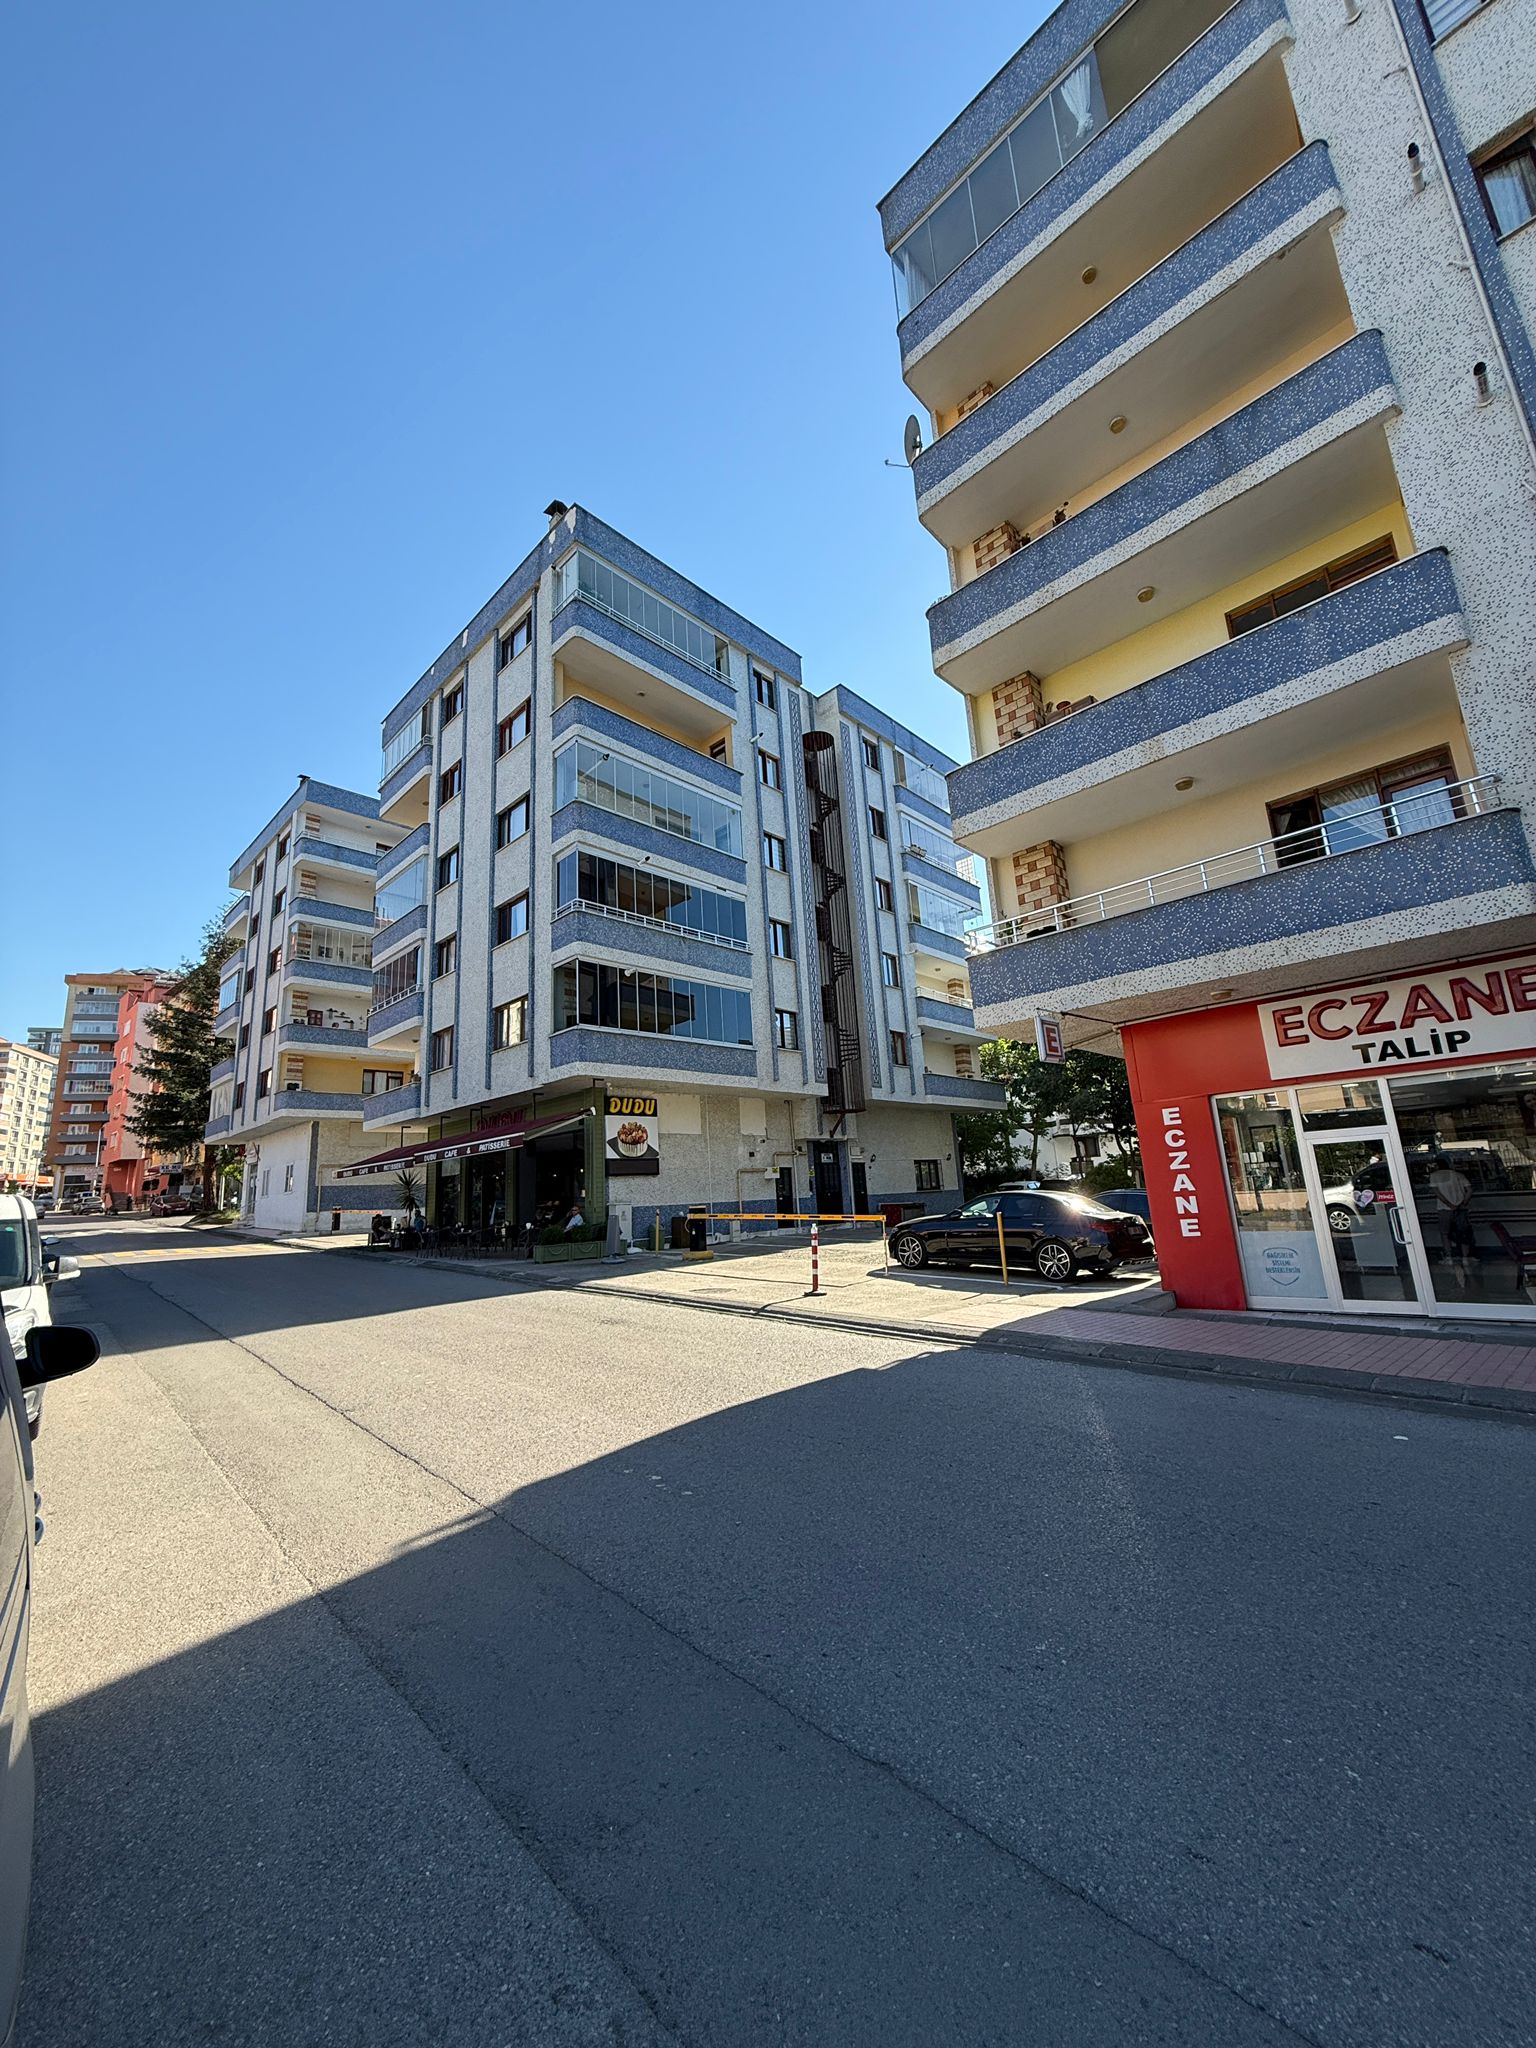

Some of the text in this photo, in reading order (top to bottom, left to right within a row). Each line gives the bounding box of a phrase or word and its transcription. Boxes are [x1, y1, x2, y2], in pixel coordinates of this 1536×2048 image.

[1272, 964, 1536, 1047] ECZANE
[1045, 1026, 1060, 1053] E
[1352, 1028, 1471, 1064] TALİP
[609, 1097, 655, 1115] DUDU
[444, 1149, 458, 1158] CAFE
[1161, 1106, 1201, 1237] ECZANE
